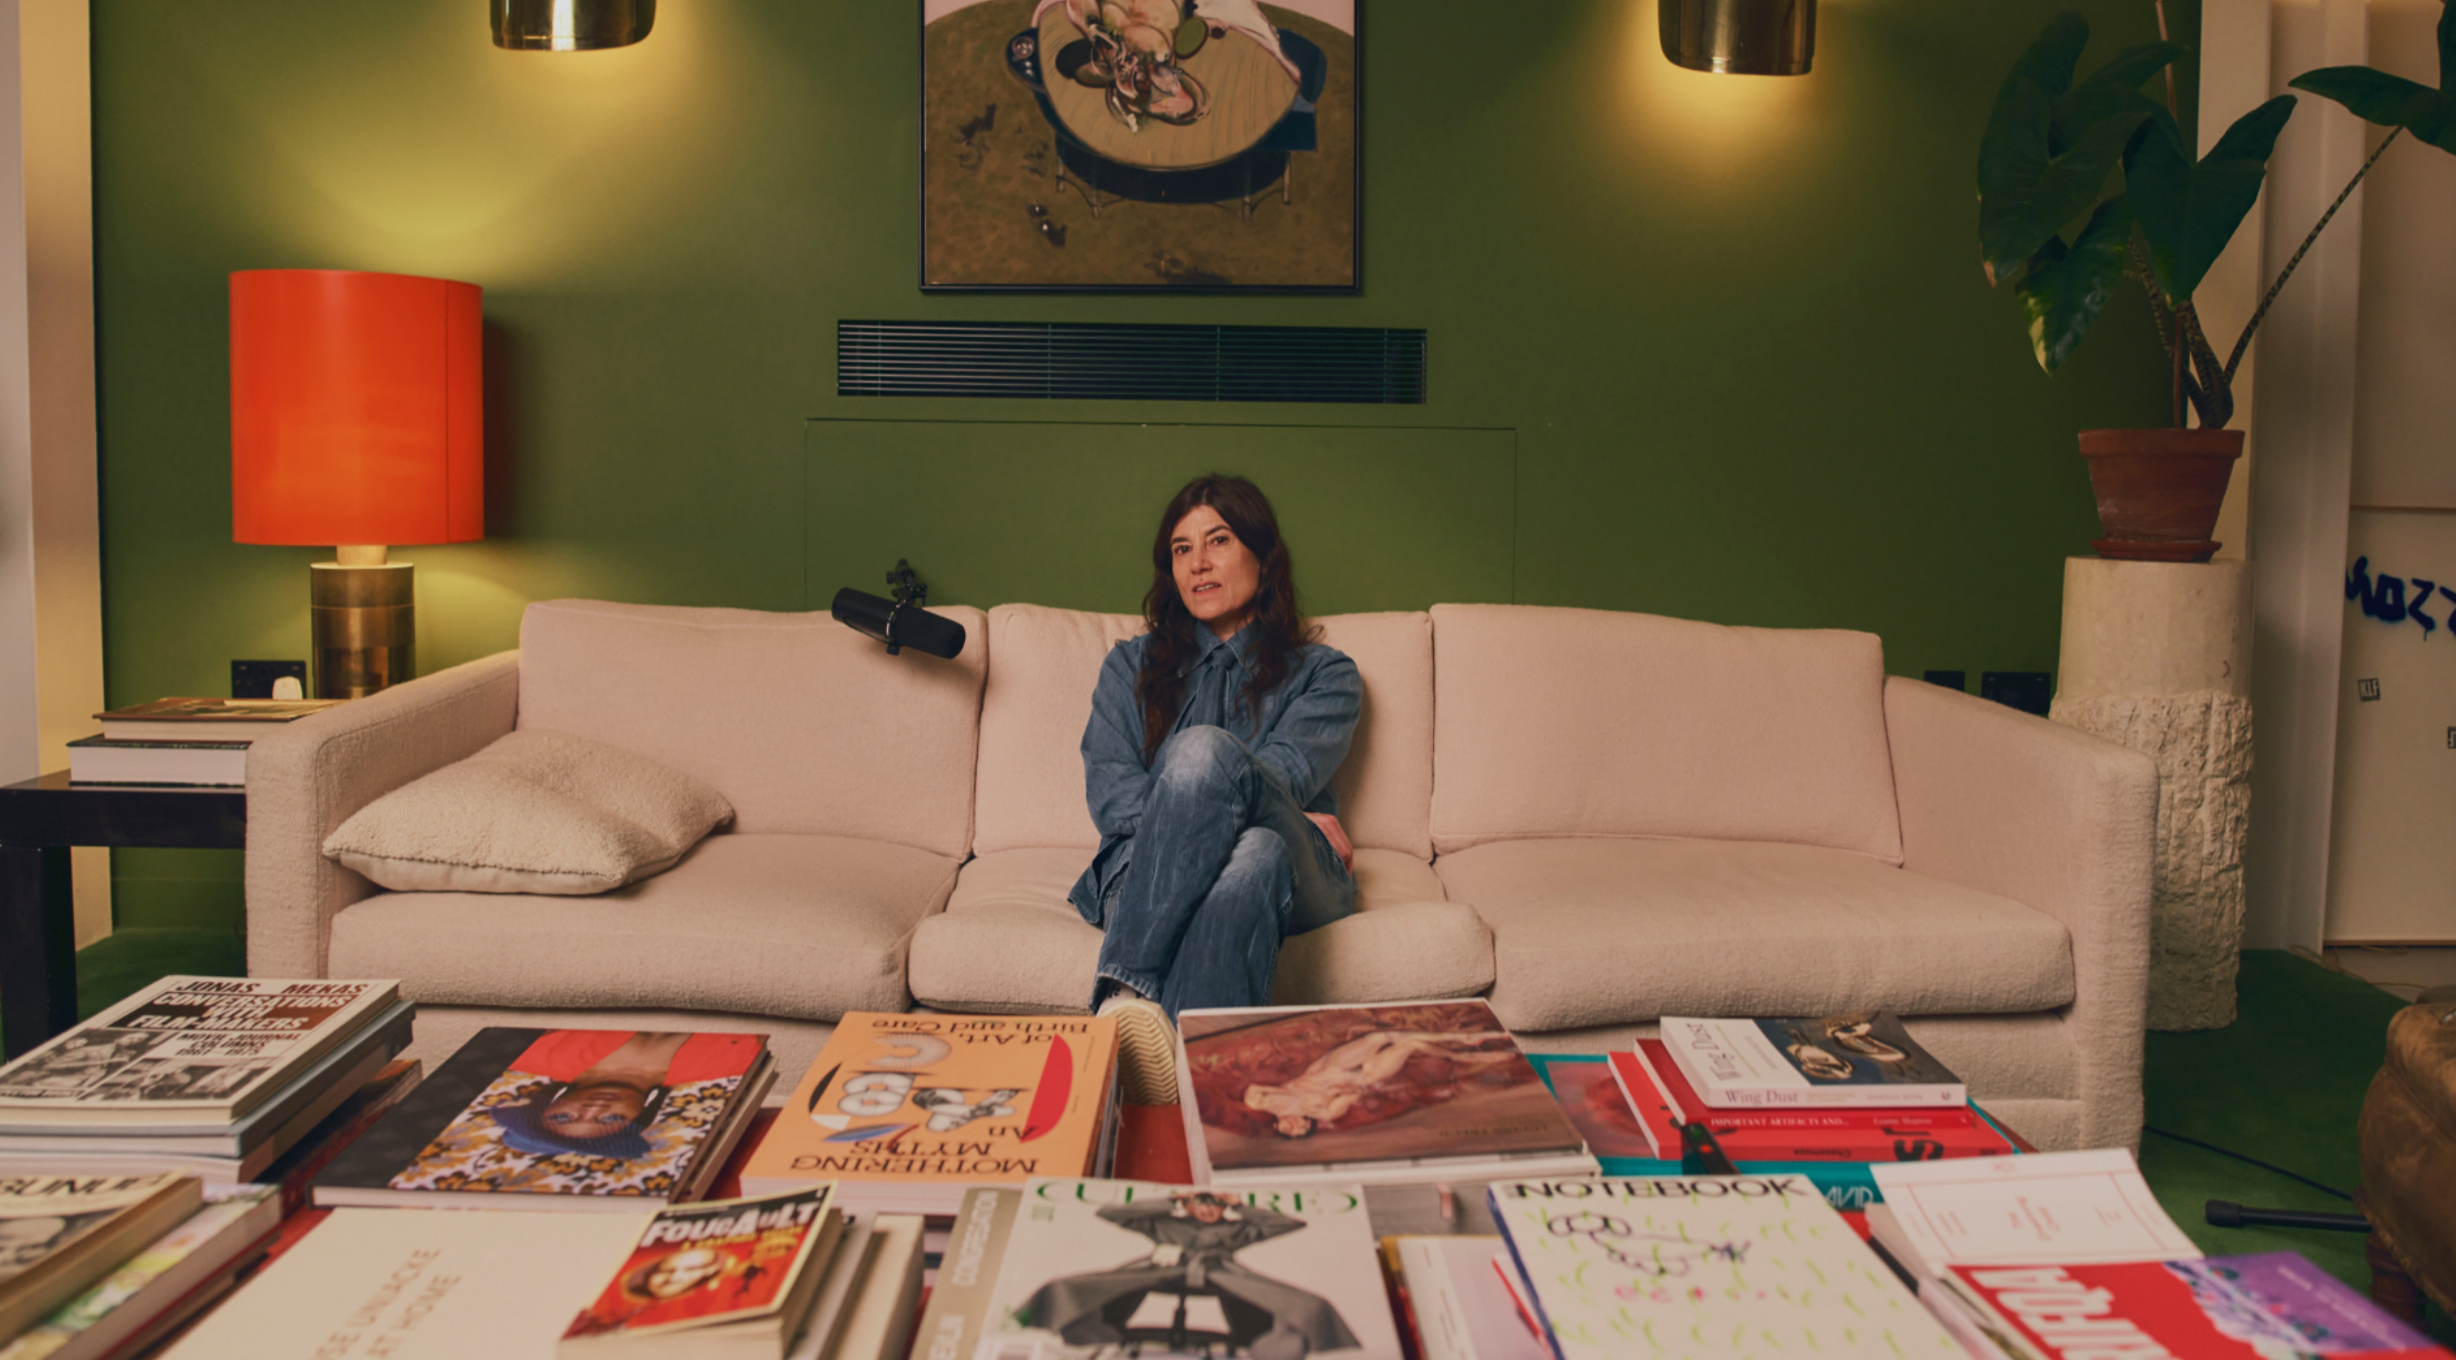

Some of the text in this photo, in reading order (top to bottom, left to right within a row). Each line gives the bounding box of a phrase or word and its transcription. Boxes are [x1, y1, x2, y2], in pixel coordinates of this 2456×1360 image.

[174, 981, 368, 994] JONAS MEKAS
[152, 992, 353, 1008] CONVERSATIONS
[202, 1006, 274, 1018] WITH
[127, 1015, 309, 1029] FILM-MAKERS
[871, 1019, 1089, 1034] Birth and Care
[229, 1033, 302, 1041] JOURNAL
[957, 1032, 1053, 1045] of Art,
[1725, 1090, 1762, 1106] Wing
[1766, 1089, 1798, 1102] Dust
[1710, 1117, 1767, 1126] IMPORTANT
[1769, 1117, 1822, 1126] ARTIFACTS
[987, 1125, 1040, 1141] An
[849, 1141, 995, 1156] MYTHS
[789, 1155, 1041, 1175] MOTHERING
[1514, 1177, 1810, 1198] NOTEBOOK
[639, 1200, 821, 1248] FOUCAULT
